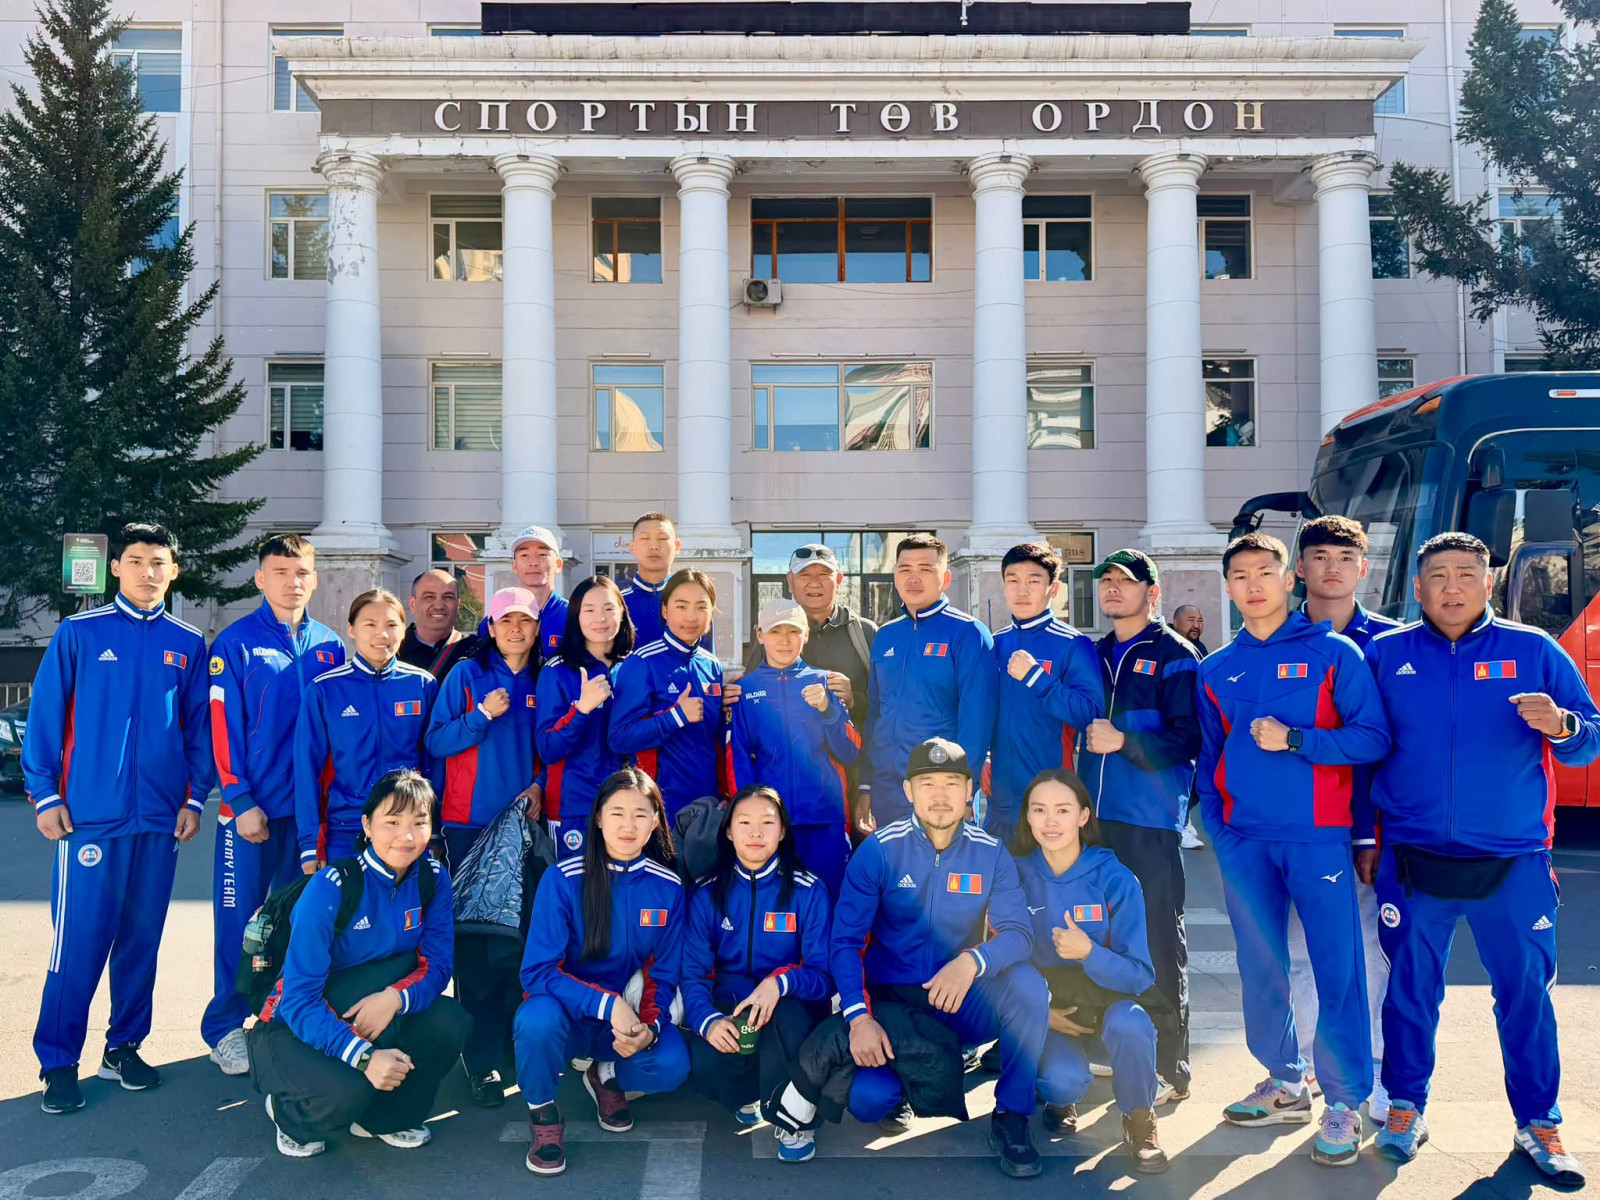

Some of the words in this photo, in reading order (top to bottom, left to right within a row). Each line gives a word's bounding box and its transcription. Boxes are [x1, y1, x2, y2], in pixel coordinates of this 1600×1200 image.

[434, 101, 758, 133] СПОРТЫН
[830, 102, 960, 132] ТӨВ
[1032, 100, 1265, 134] ОРДОН
[745, 689, 767, 700] ALDAR
[224, 828, 235, 869] ARMY
[223, 871, 236, 908] TEAM
